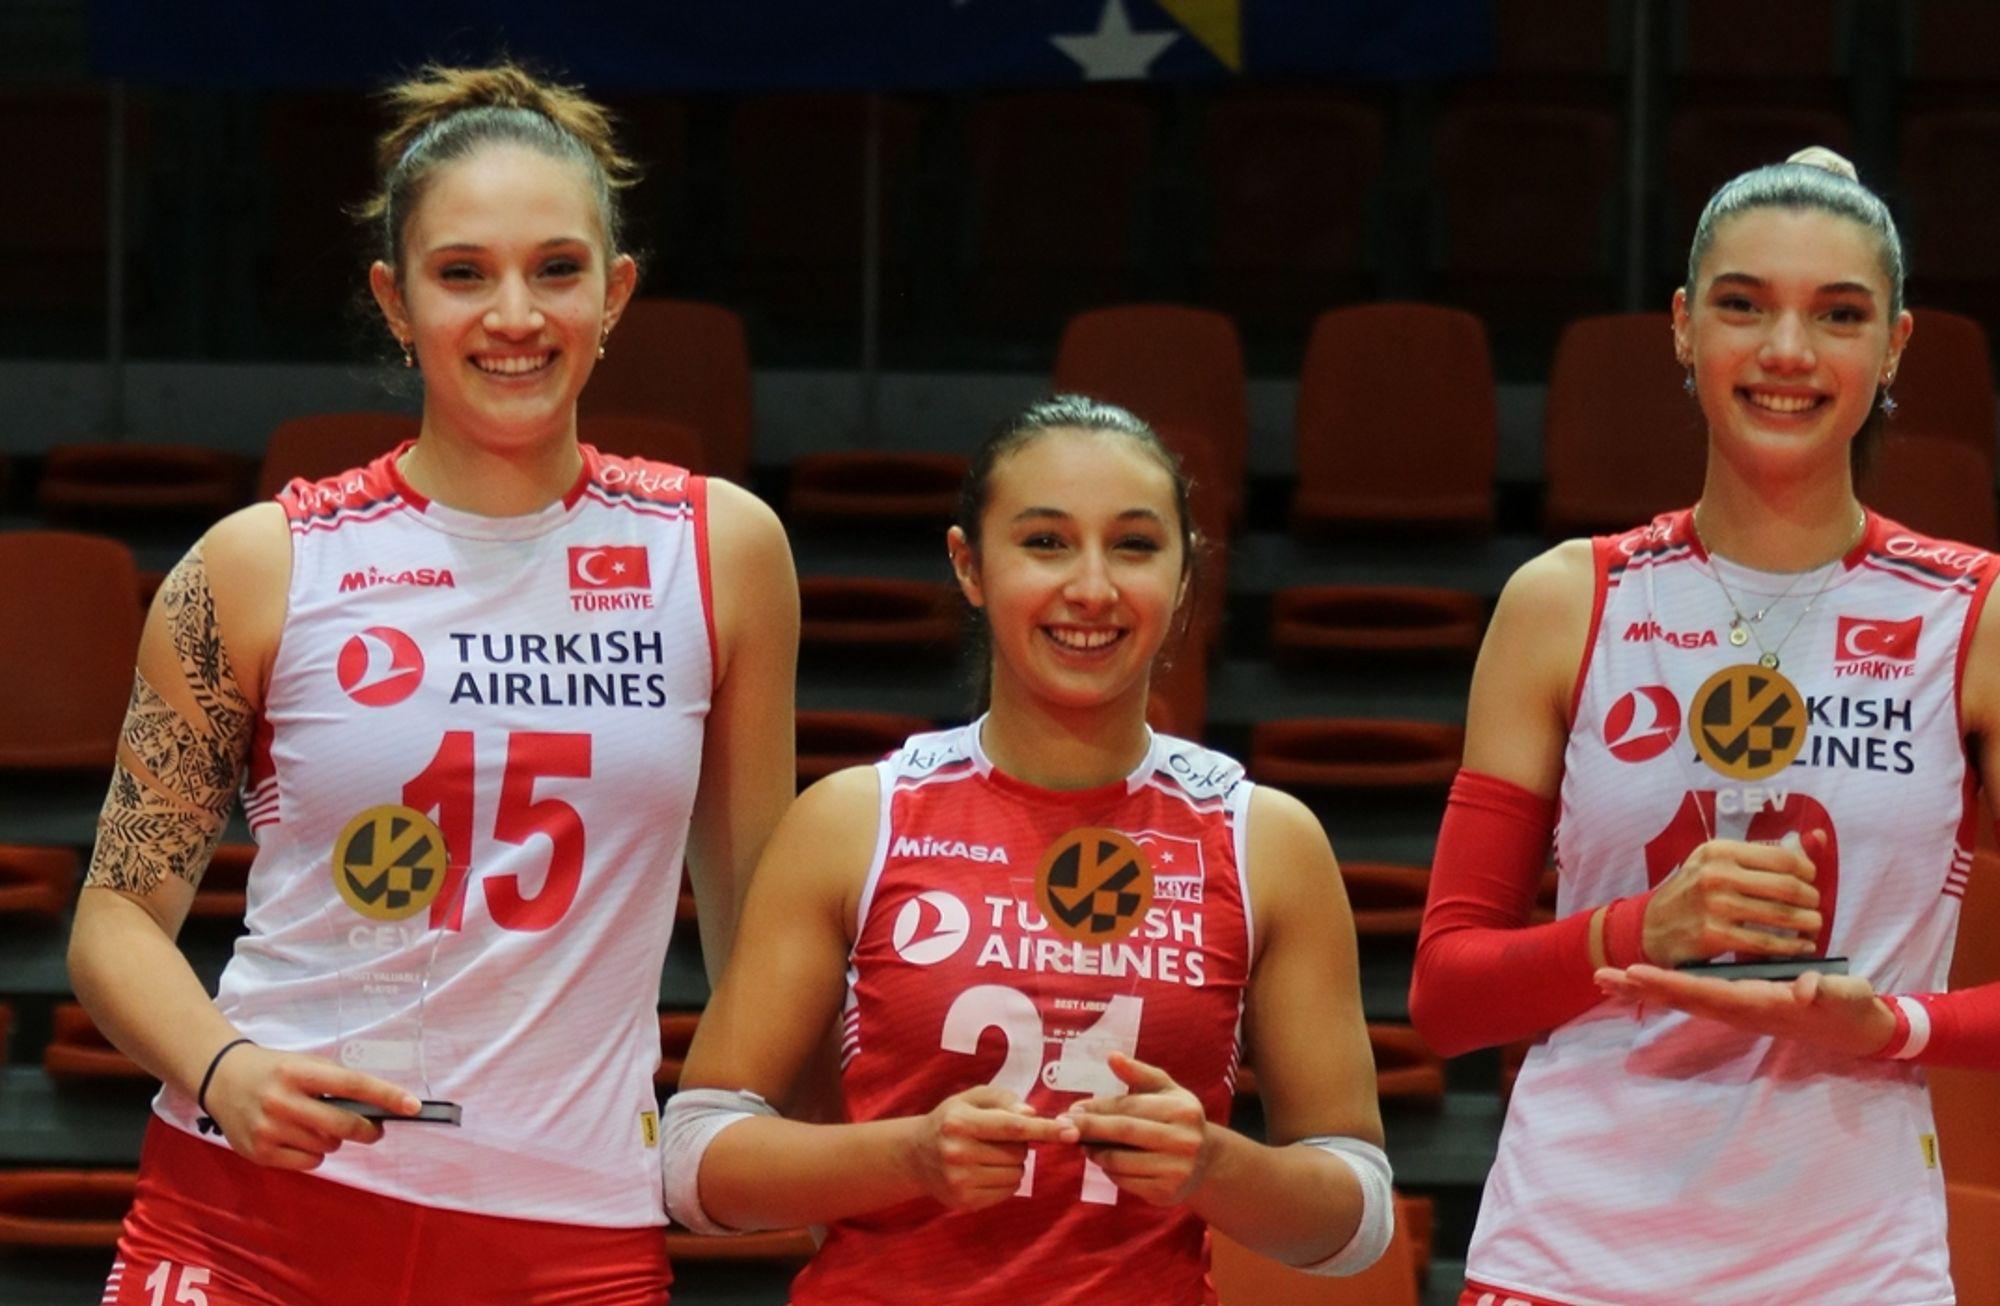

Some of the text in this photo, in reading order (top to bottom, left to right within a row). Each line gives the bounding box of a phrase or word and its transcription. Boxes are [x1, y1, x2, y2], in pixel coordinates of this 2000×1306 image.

[600, 464, 685, 493] Orkid
[450, 630, 663, 665] TURKISH
[449, 672, 666, 708] AIRLINES
[1806, 694, 1912, 733] KISH
[1714, 788, 1789, 814] CEV
[402, 730, 592, 933] 15
[144, 1260, 211, 1306] 15
